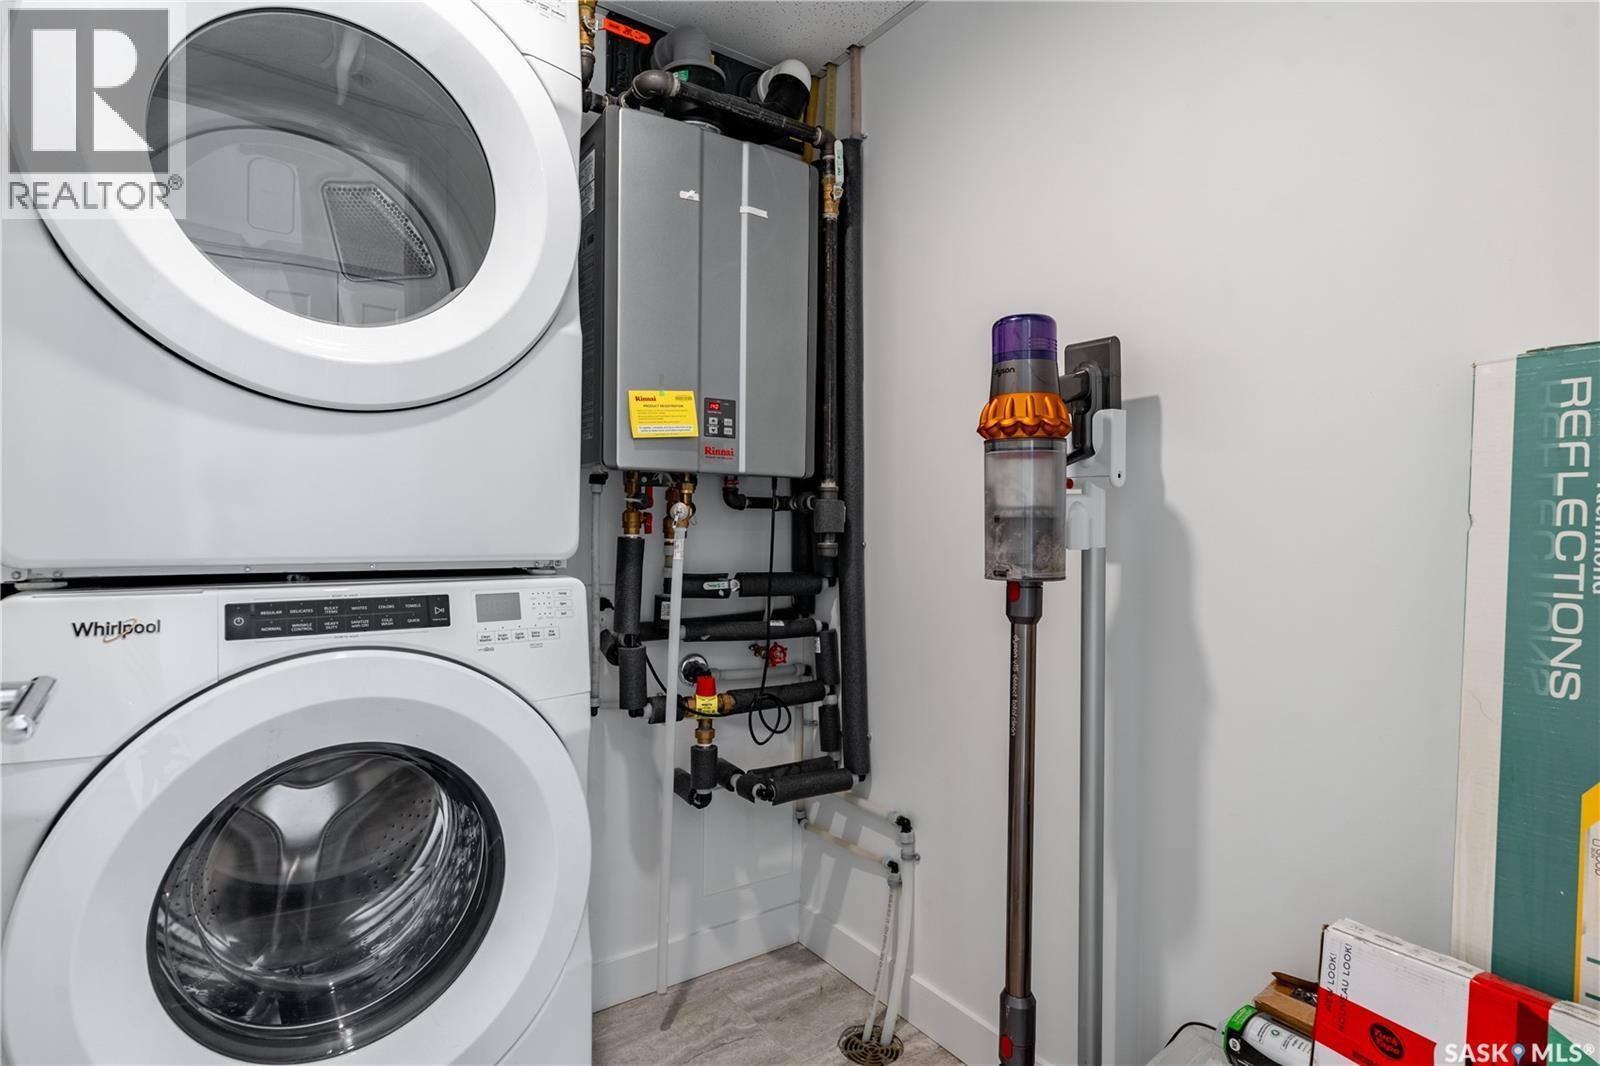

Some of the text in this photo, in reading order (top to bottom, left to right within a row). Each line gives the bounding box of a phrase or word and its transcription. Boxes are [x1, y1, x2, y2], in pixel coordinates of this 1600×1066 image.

[704, 446, 734, 456] Rinnai
[1550, 376, 1592, 701] REFLECTIONS
[72, 619, 161, 639] Whirlpool
[1327, 952, 1337, 985] LOOK!
[1343, 943, 1353, 976] LOOK!
